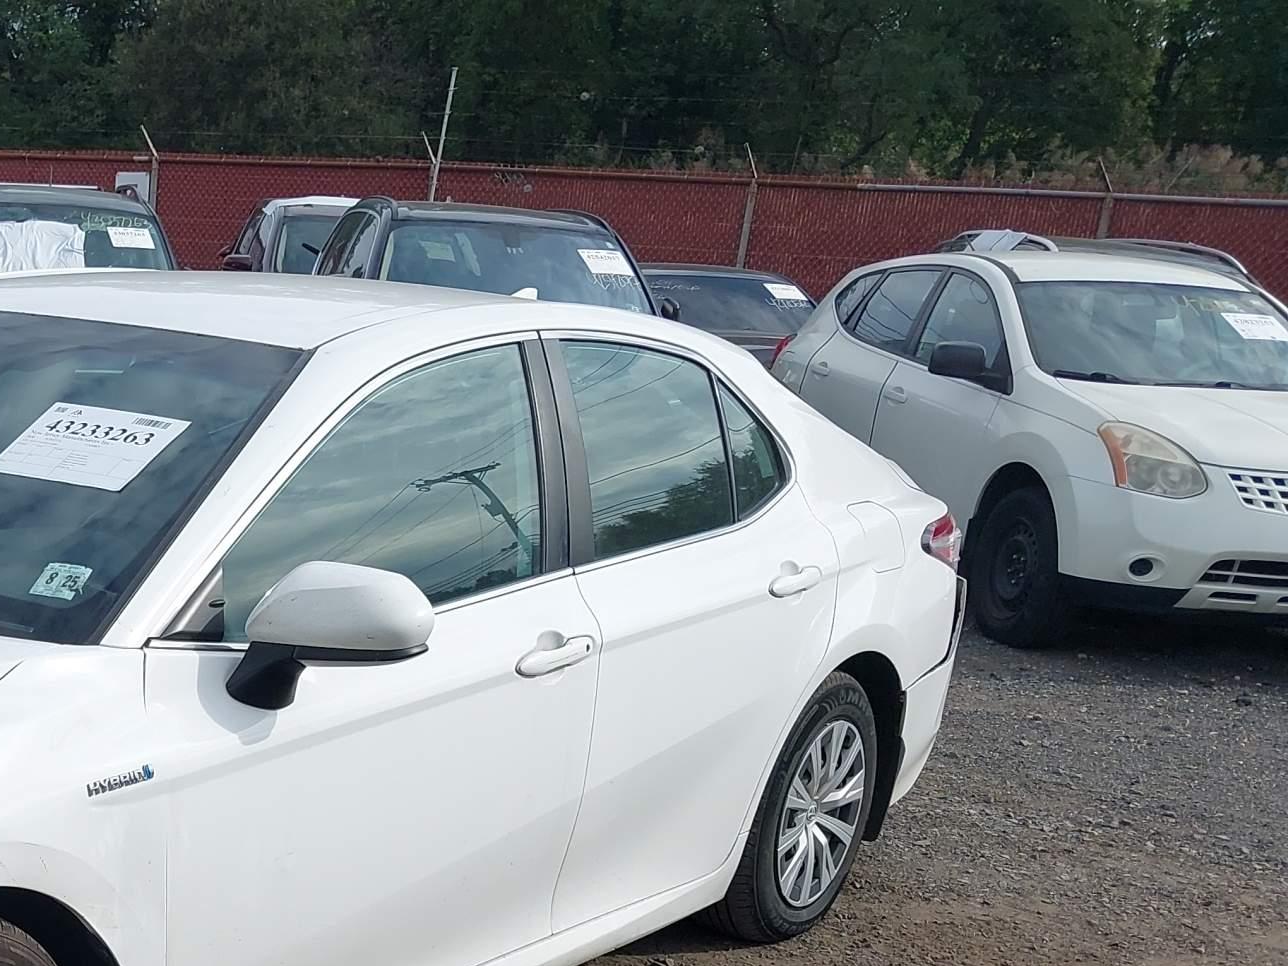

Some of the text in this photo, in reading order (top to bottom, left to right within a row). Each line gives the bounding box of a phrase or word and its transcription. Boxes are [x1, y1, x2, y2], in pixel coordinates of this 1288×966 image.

[45, 418, 155, 446] 43233263
[45, 572, 59, 585] 8
[86, 769, 145, 798] HYBRID
